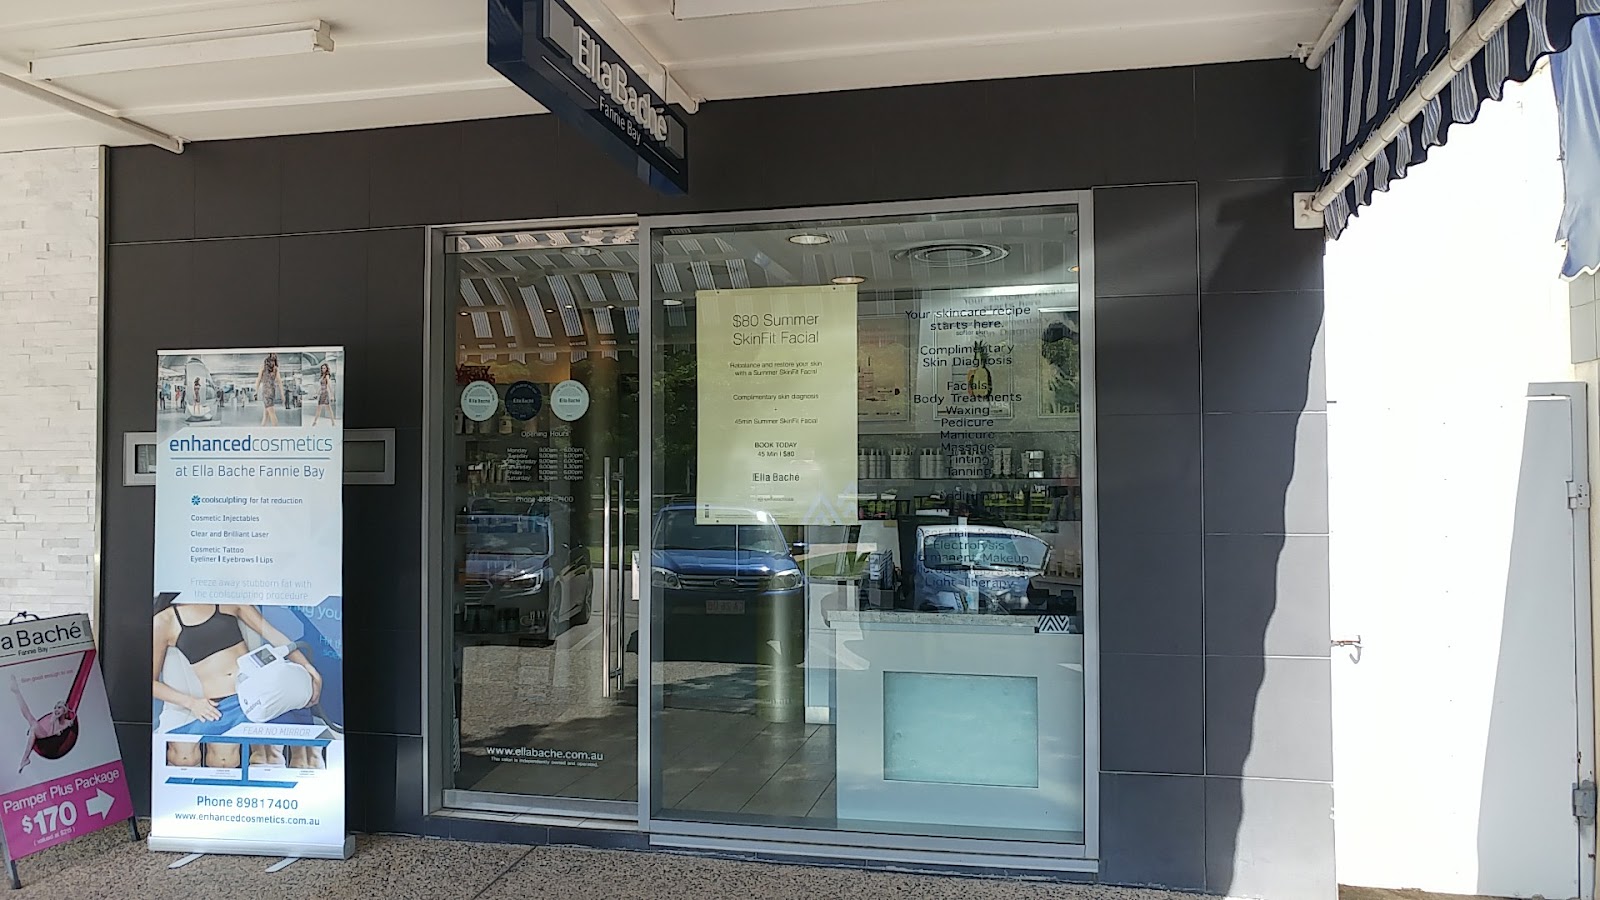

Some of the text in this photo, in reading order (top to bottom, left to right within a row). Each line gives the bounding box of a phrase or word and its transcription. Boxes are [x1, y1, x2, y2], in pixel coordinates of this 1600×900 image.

[575, 25, 668, 142] Ella Baché
[599, 96, 642, 146] Fannie Bay
[905, 306, 1031, 320] Your skincare recipe
[732, 313, 819, 328] $80 Summer
[930, 320, 968, 331] starts
[732, 330, 819, 346] SkinFit Facial
[922, 355, 1012, 368] Skin Diagnosis
[946, 381, 987, 391] Facials
[791, 393, 819, 401] diagnosis
[913, 393, 1022, 405] Body Treatments
[945, 405, 990, 416] Waxing
[941, 417, 994, 428] Pedicure
[940, 429, 995, 440] Manicure
[169, 434, 333, 452] enhancedcosmetics
[940, 442, 995, 454] Massage
[946, 455, 990, 465] Tinting
[175, 464, 325, 480] at Ella Bache Fannie Bay
[754, 472, 771, 482] Ella
[946, 466, 992, 478] Tanning
[201, 496, 248, 506] coolsculpting
[250, 496, 258, 504] for
[260, 496, 269, 504] fat
[190, 514, 260, 523] Cosmetic Injectables
[209, 530, 222, 538] and
[223, 530, 250, 538] Brilliant
[222, 546, 245, 554] Tattoo
[933, 540, 1005, 552] Electrolysis
[190, 555, 216, 563] Eyeliner
[222, 556, 254, 564] Eyebrows
[260, 556, 274, 564] Lips
[914, 553, 1029, 565] ermanent Makeup
[190, 577, 312, 588] Freeze away stubborn fat with
[925, 577, 956, 589] Light
[194, 590, 308, 600] the coolsculpting procedure
[16, 621, 82, 648] Baché
[243, 727, 311, 736] FEAR NO MIRROR
[486, 746, 604, 761] www.ellabache.com.au
[3, 769, 120, 814] Pamper Plus Package
[197, 795, 299, 811] Phone 89817400
[21, 800, 78, 836] $170
[175, 811, 320, 826] www.enhancedcosmetics.com.au
